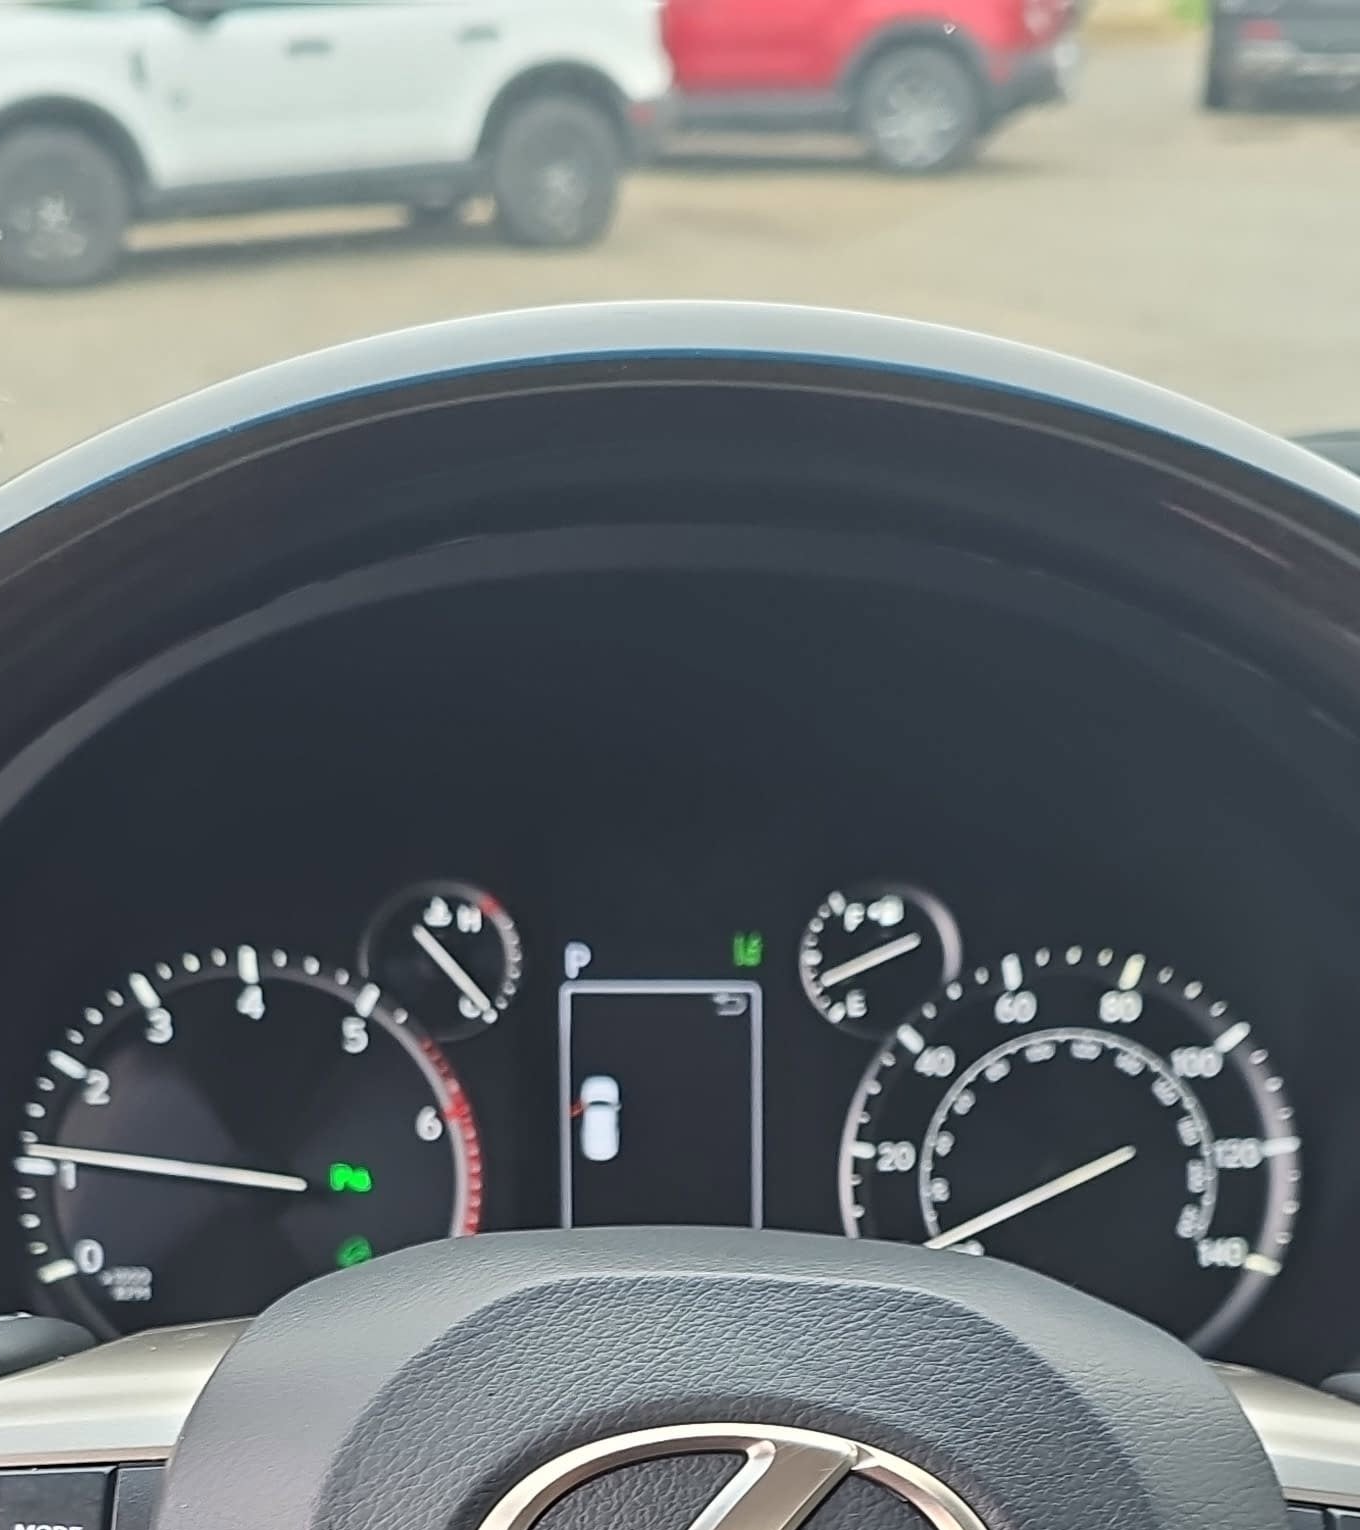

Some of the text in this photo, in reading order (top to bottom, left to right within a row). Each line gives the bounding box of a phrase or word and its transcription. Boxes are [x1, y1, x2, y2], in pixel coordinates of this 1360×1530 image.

[564, 941, 592, 979] P
[236, 984, 266, 1020] 4
[993, 989, 1038, 1025] 60
[1098, 989, 1144, 1025] 80
[145, 1006, 174, 1044] 3
[341, 1016, 369, 1054] 5
[914, 1044, 956, 1078] 40
[1170, 1045, 1224, 1079] 100
[82, 1068, 111, 1106] 2
[415, 1105, 443, 1142] 6
[876, 1140, 917, 1173] 20
[1214, 1136, 1263, 1169] 120
[74, 1238, 105, 1274] 0
